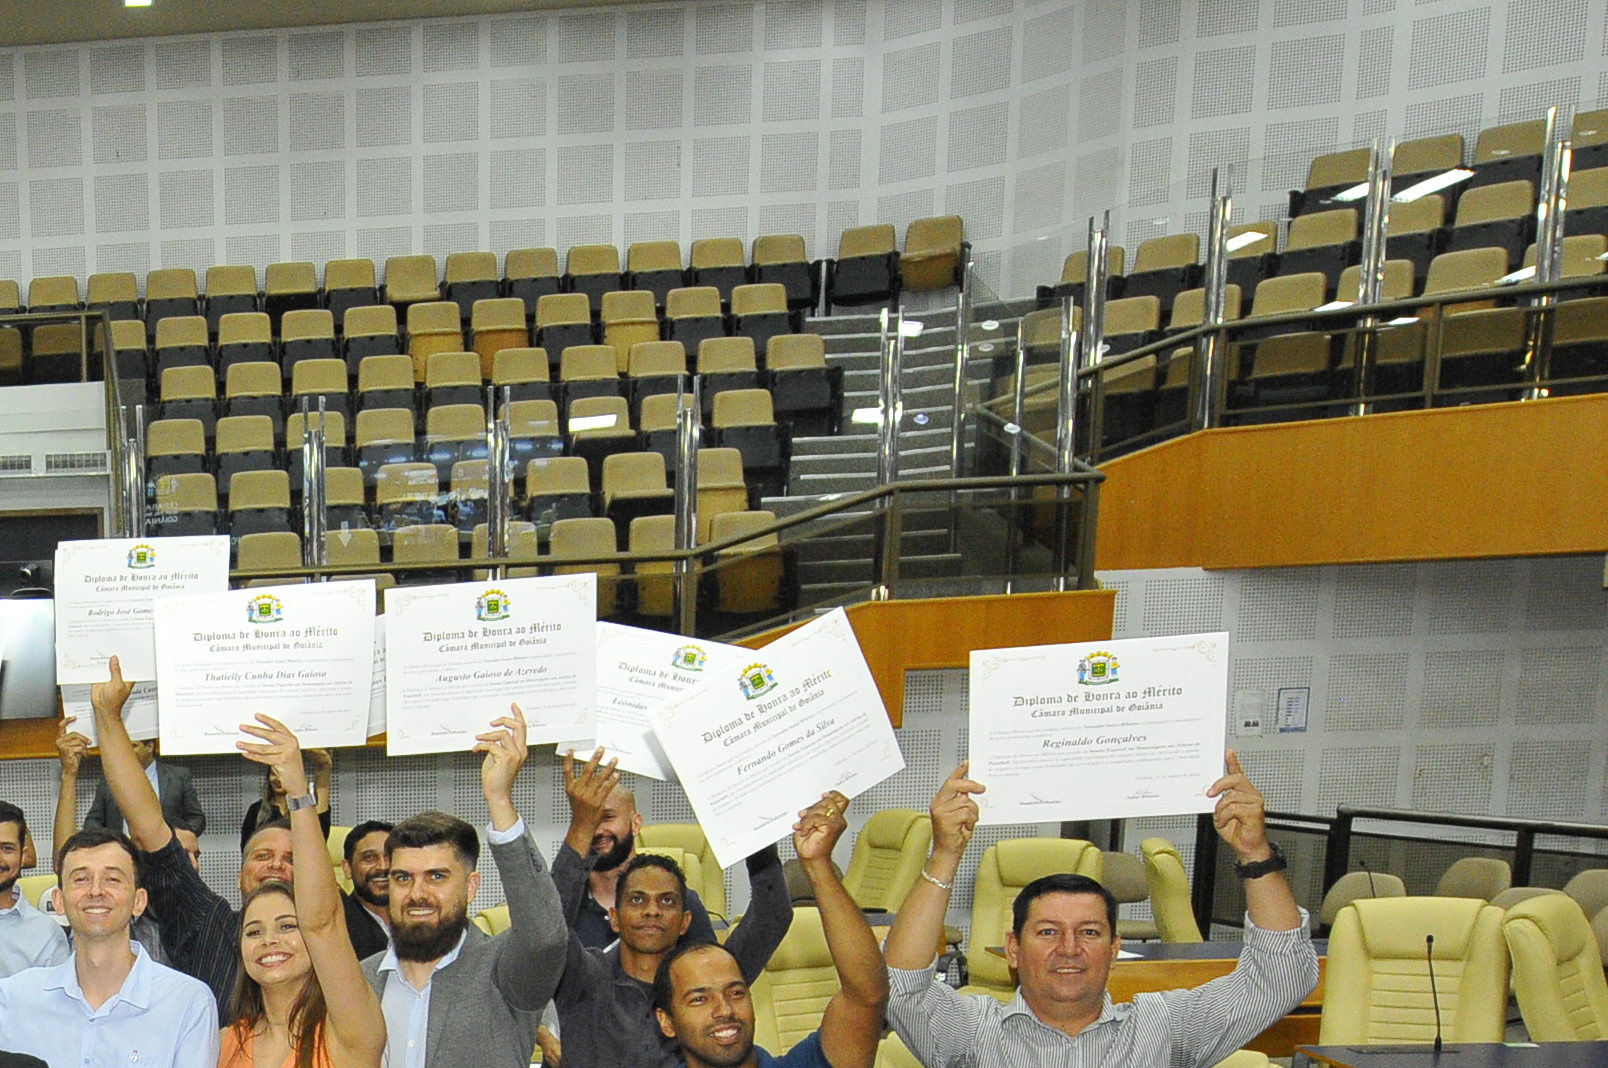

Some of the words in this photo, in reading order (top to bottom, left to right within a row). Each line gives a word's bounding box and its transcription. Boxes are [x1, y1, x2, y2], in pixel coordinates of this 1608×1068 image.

[87, 608, 114, 617] Rodrigo
[115, 607, 131, 615] José
[192, 631, 236, 642] Diploma
[238, 630, 250, 639] de
[253, 628, 286, 639] Honra
[288, 629, 301, 637] ao
[303, 625, 338, 638] Mérito
[422, 630, 465, 642] Diploma
[467, 628, 478, 638] de
[481, 626, 512, 638] Honra
[514, 625, 526, 634] ao
[528, 620, 561, 634] Mérito
[243, 670, 274, 680] Cunha
[275, 670, 295, 679] Dias
[297, 669, 327, 678] Gaioso
[435, 673, 471, 683] Augusto
[472, 669, 502, 679] Gaioso
[502, 667, 513, 677] de
[514, 664, 547, 676] Azevedo
[1012, 695, 1063, 707] Diploma
[1065, 692, 1079, 703] de
[1083, 690, 1121, 702] Honra
[1124, 690, 1138, 699] ao
[1141, 684, 1182, 699] Mérito
[700, 717, 743, 744] Diploma
[742, 710, 755, 721] de
[755, 693, 788, 714] Honra
[789, 686, 801, 698] ao
[1030, 708, 1066, 718] Câmara
[1067, 704, 1113, 716] Municipal
[1115, 704, 1125, 713] de
[1127, 700, 1163, 712] Goiânia
[736, 749, 776, 775] Fernando
[776, 735, 804, 753] Gomes
[804, 728, 815, 739] da
[815, 717, 835, 733] Silva
[1041, 736, 1093, 749] Reginaldo
[1095, 733, 1147, 745] Gonçalves
